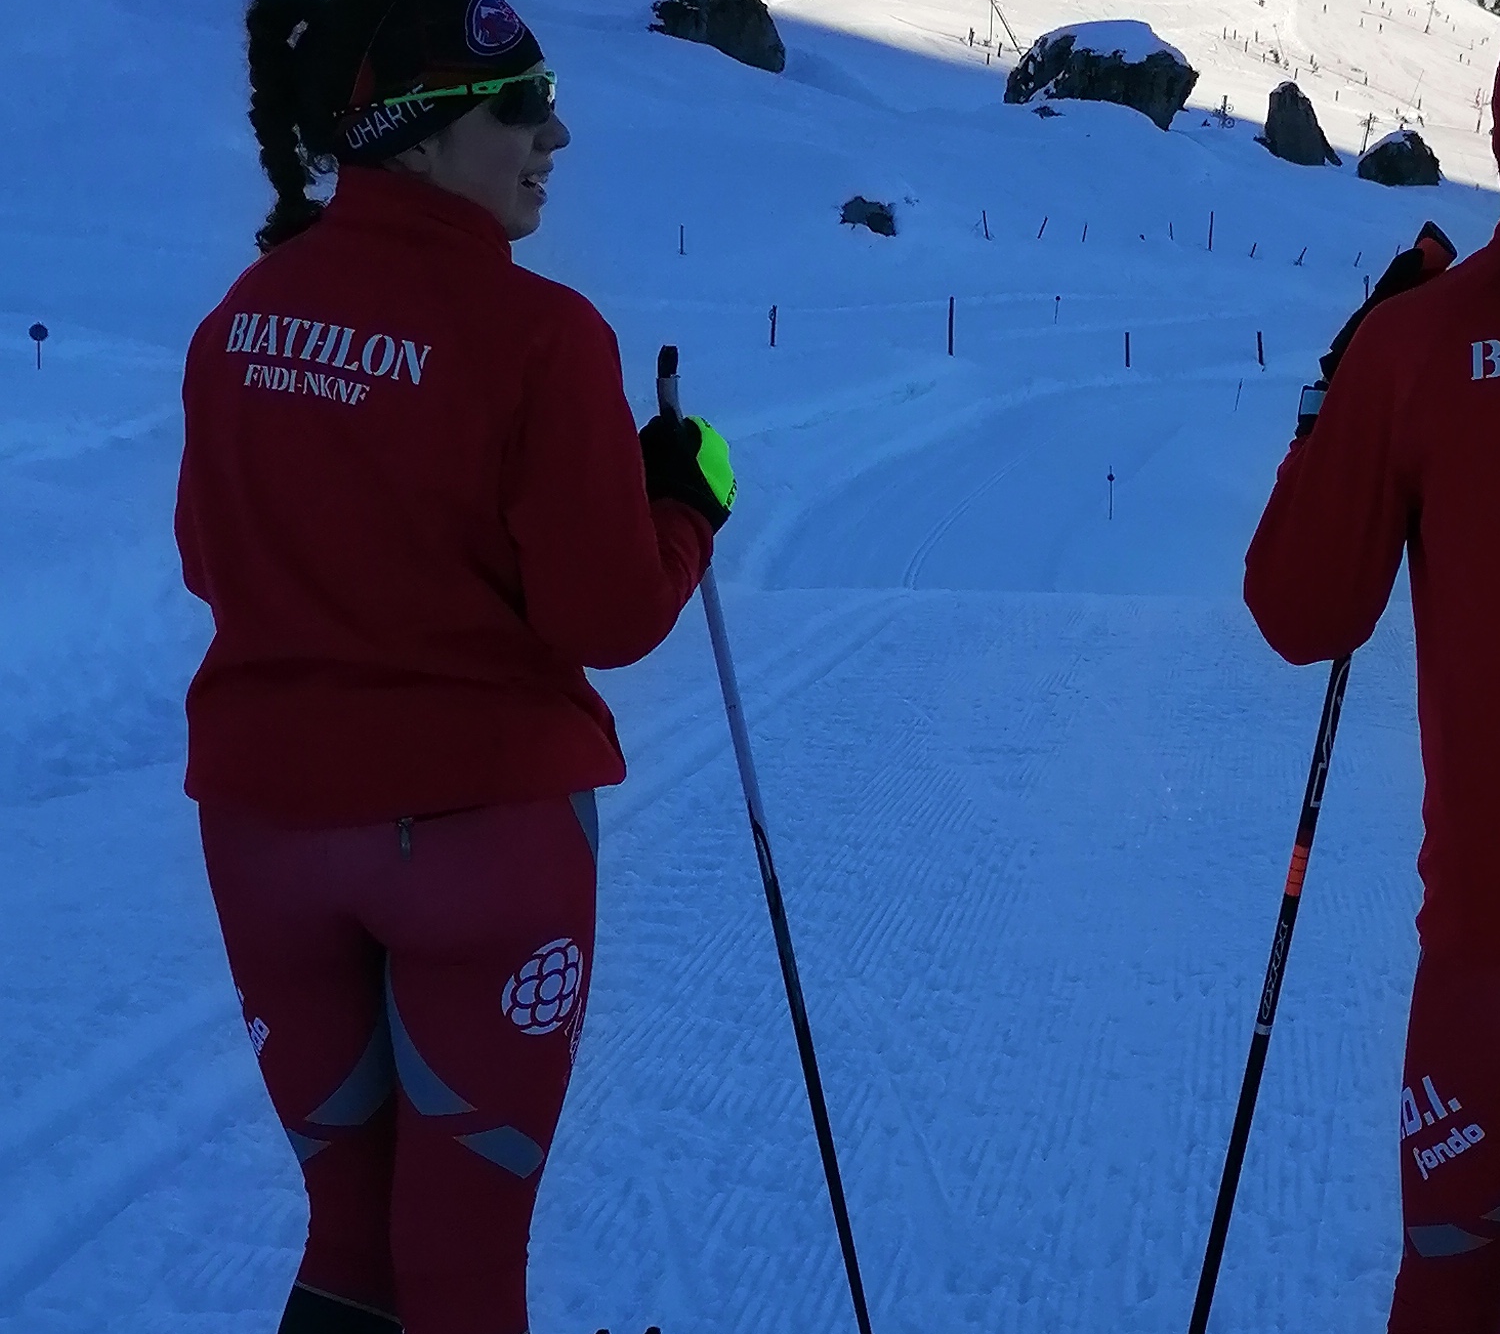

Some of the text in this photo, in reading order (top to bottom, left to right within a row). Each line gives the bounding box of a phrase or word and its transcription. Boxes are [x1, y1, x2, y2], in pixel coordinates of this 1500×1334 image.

[226, 313, 432, 385] BIATHLON
[243, 363, 370, 407] FNDI-NKNF
[1412, 1121, 1487, 1181] fondo
